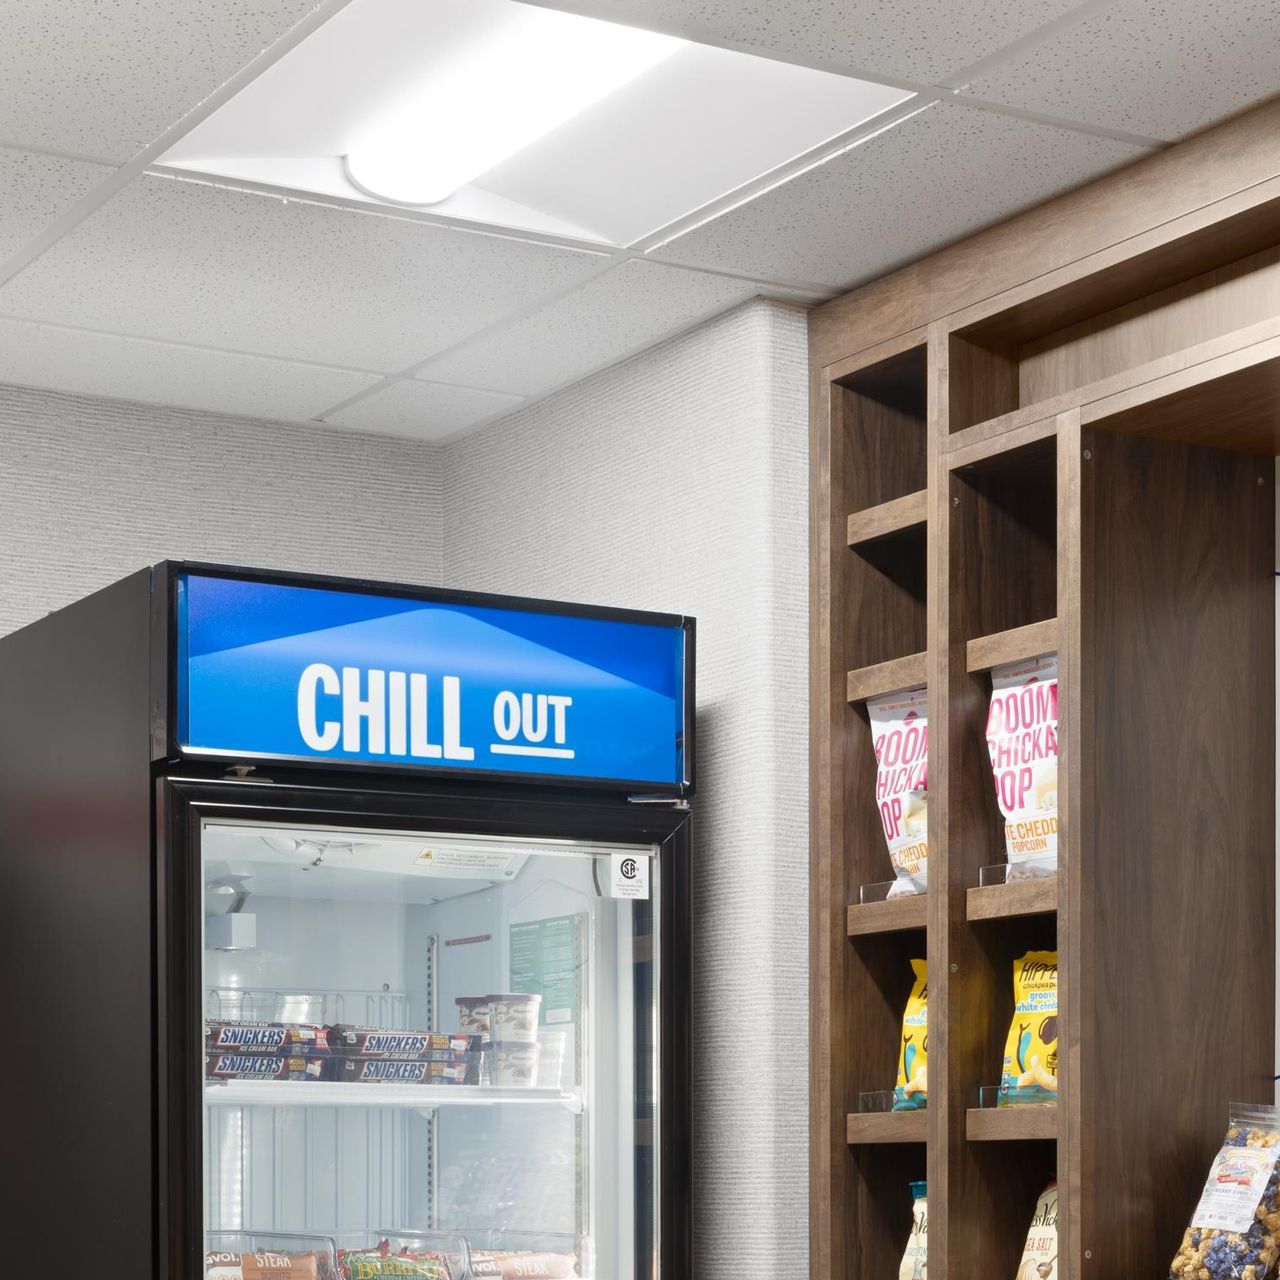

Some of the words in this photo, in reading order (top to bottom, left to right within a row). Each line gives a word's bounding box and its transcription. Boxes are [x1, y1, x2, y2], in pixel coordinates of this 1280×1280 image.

[297, 662, 474, 760] CHILL
[493, 691, 572, 744] OUT
[1011, 837, 1047, 852] POPCORN
[219, 1028, 286, 1046] SNICKERS
[364, 1035, 429, 1053] SNICKERS
[217, 1056, 284, 1074] SNICKERS
[363, 1062, 428, 1080] SNICKERS
[254, 1253, 292, 1269] STEAK
[514, 1263, 547, 1276] STEAK
